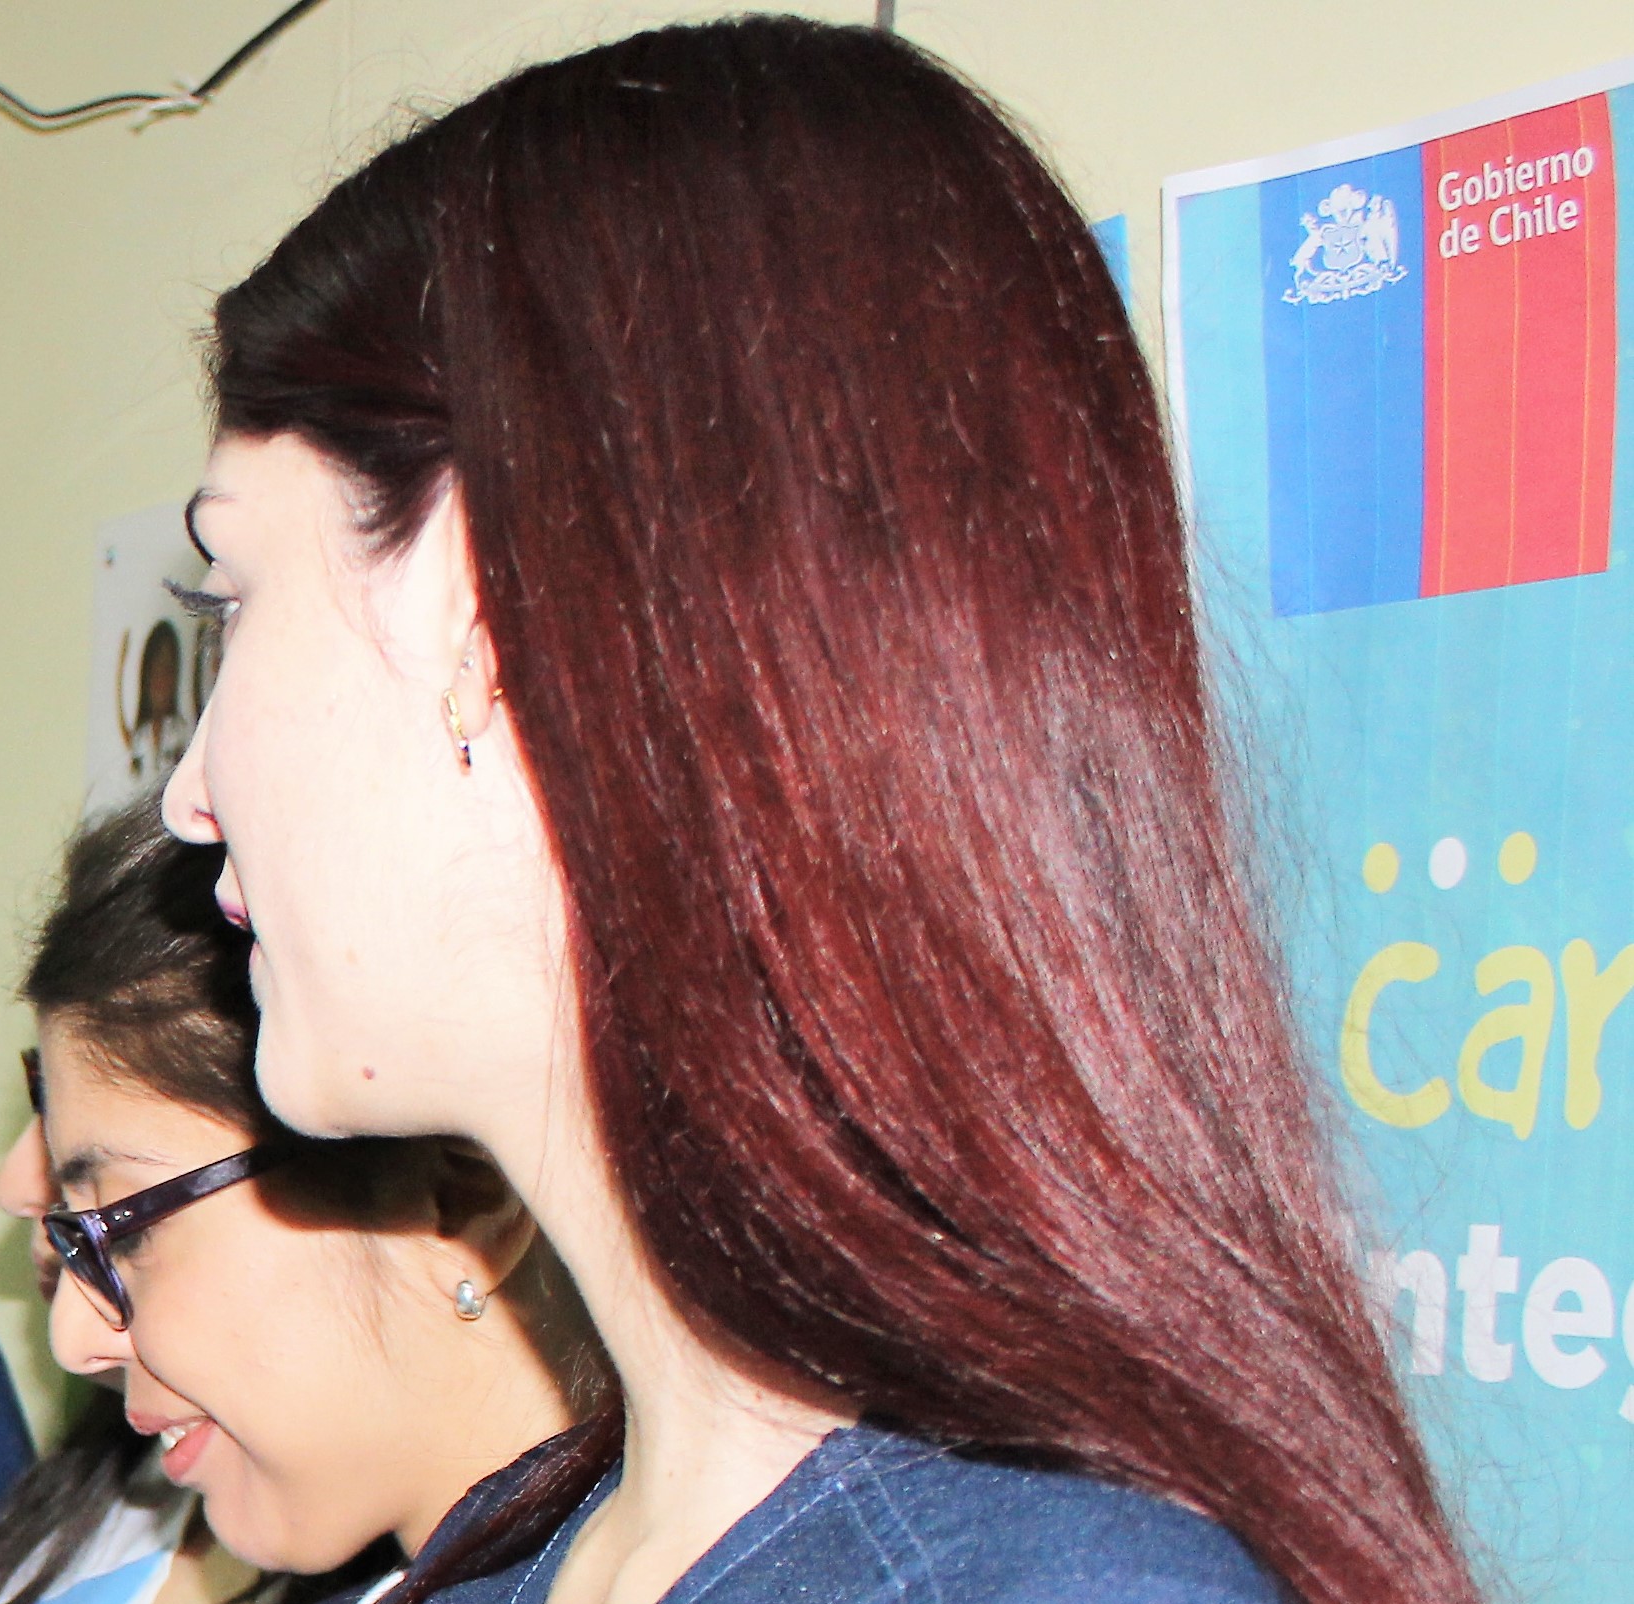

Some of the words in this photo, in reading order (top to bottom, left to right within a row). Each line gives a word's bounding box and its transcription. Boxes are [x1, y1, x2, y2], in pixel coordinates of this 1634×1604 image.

[1436, 145, 1595, 213] Gobierno
[1437, 218, 1482, 259] de
[1488, 195, 1580, 250] Chile
